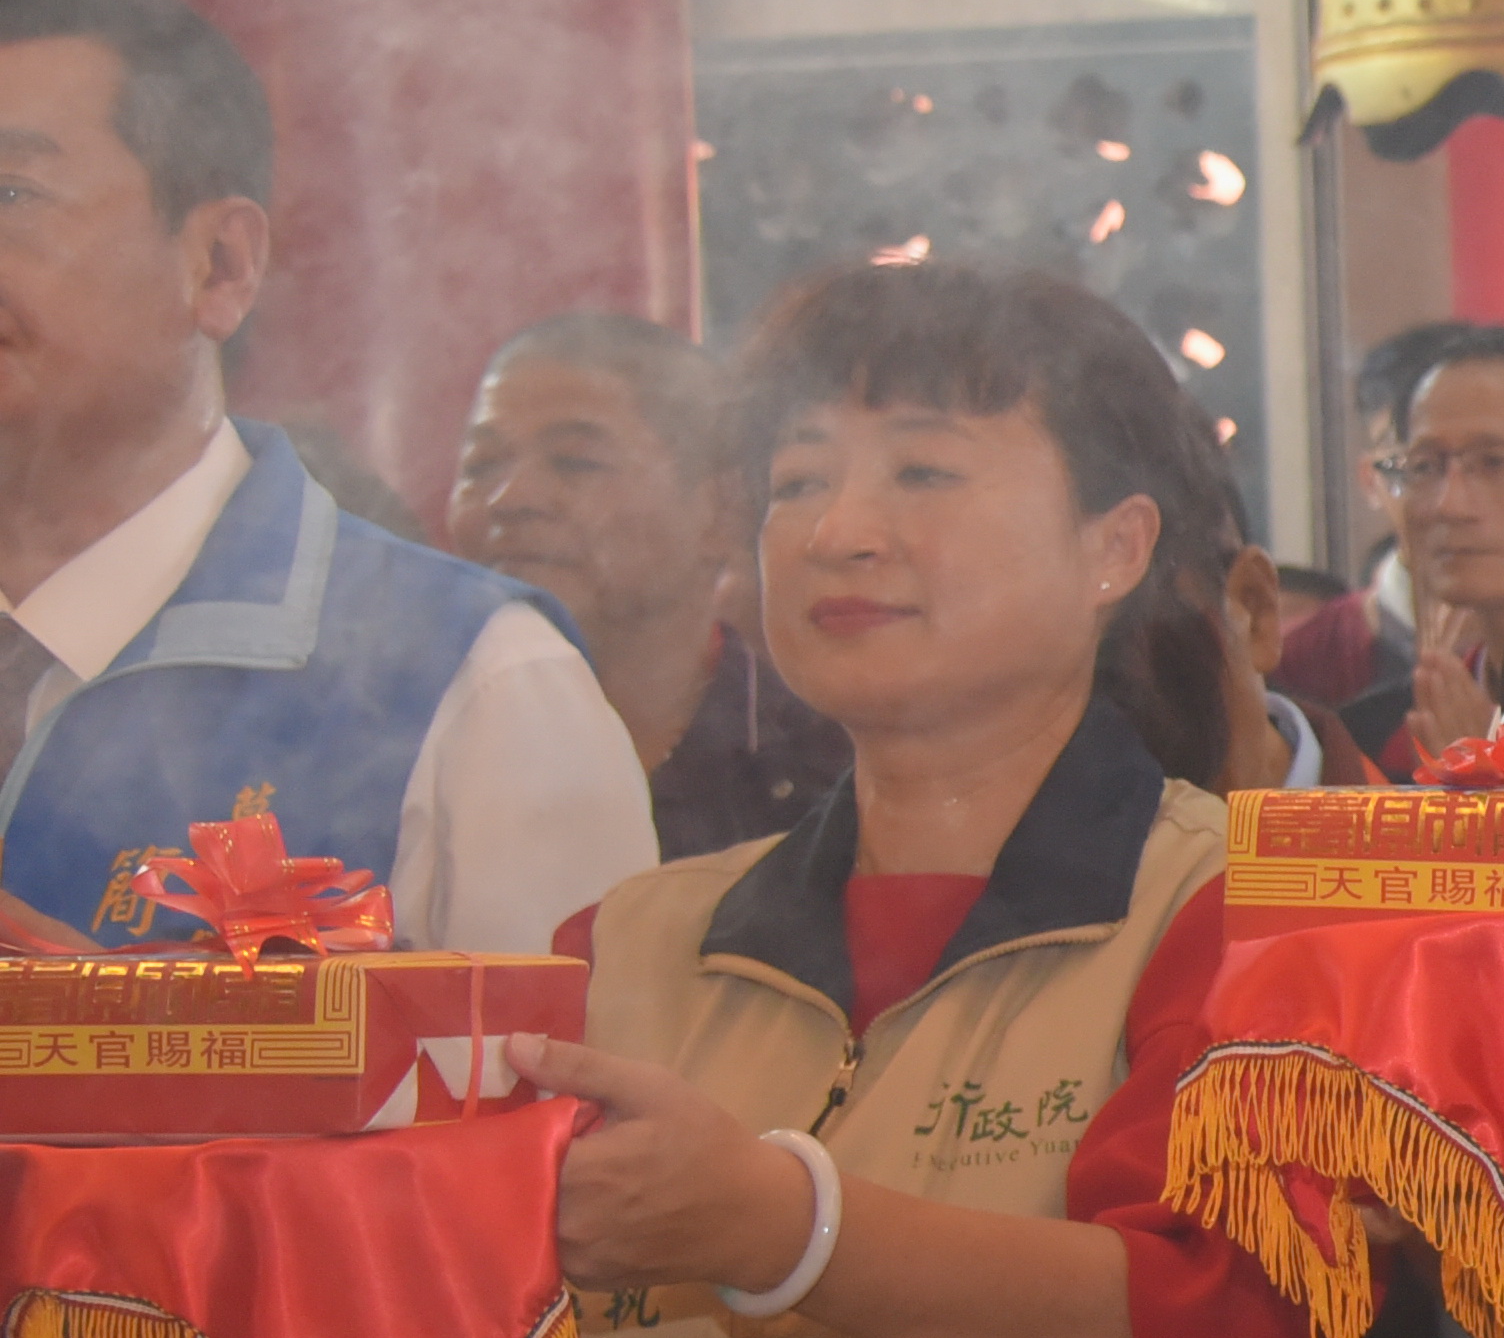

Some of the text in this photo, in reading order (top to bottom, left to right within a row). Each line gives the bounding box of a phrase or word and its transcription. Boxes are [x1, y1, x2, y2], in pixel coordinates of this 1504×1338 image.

[31, 1030, 249, 1071] 天官賜福
[913, 1079, 1090, 1142] 行政院
